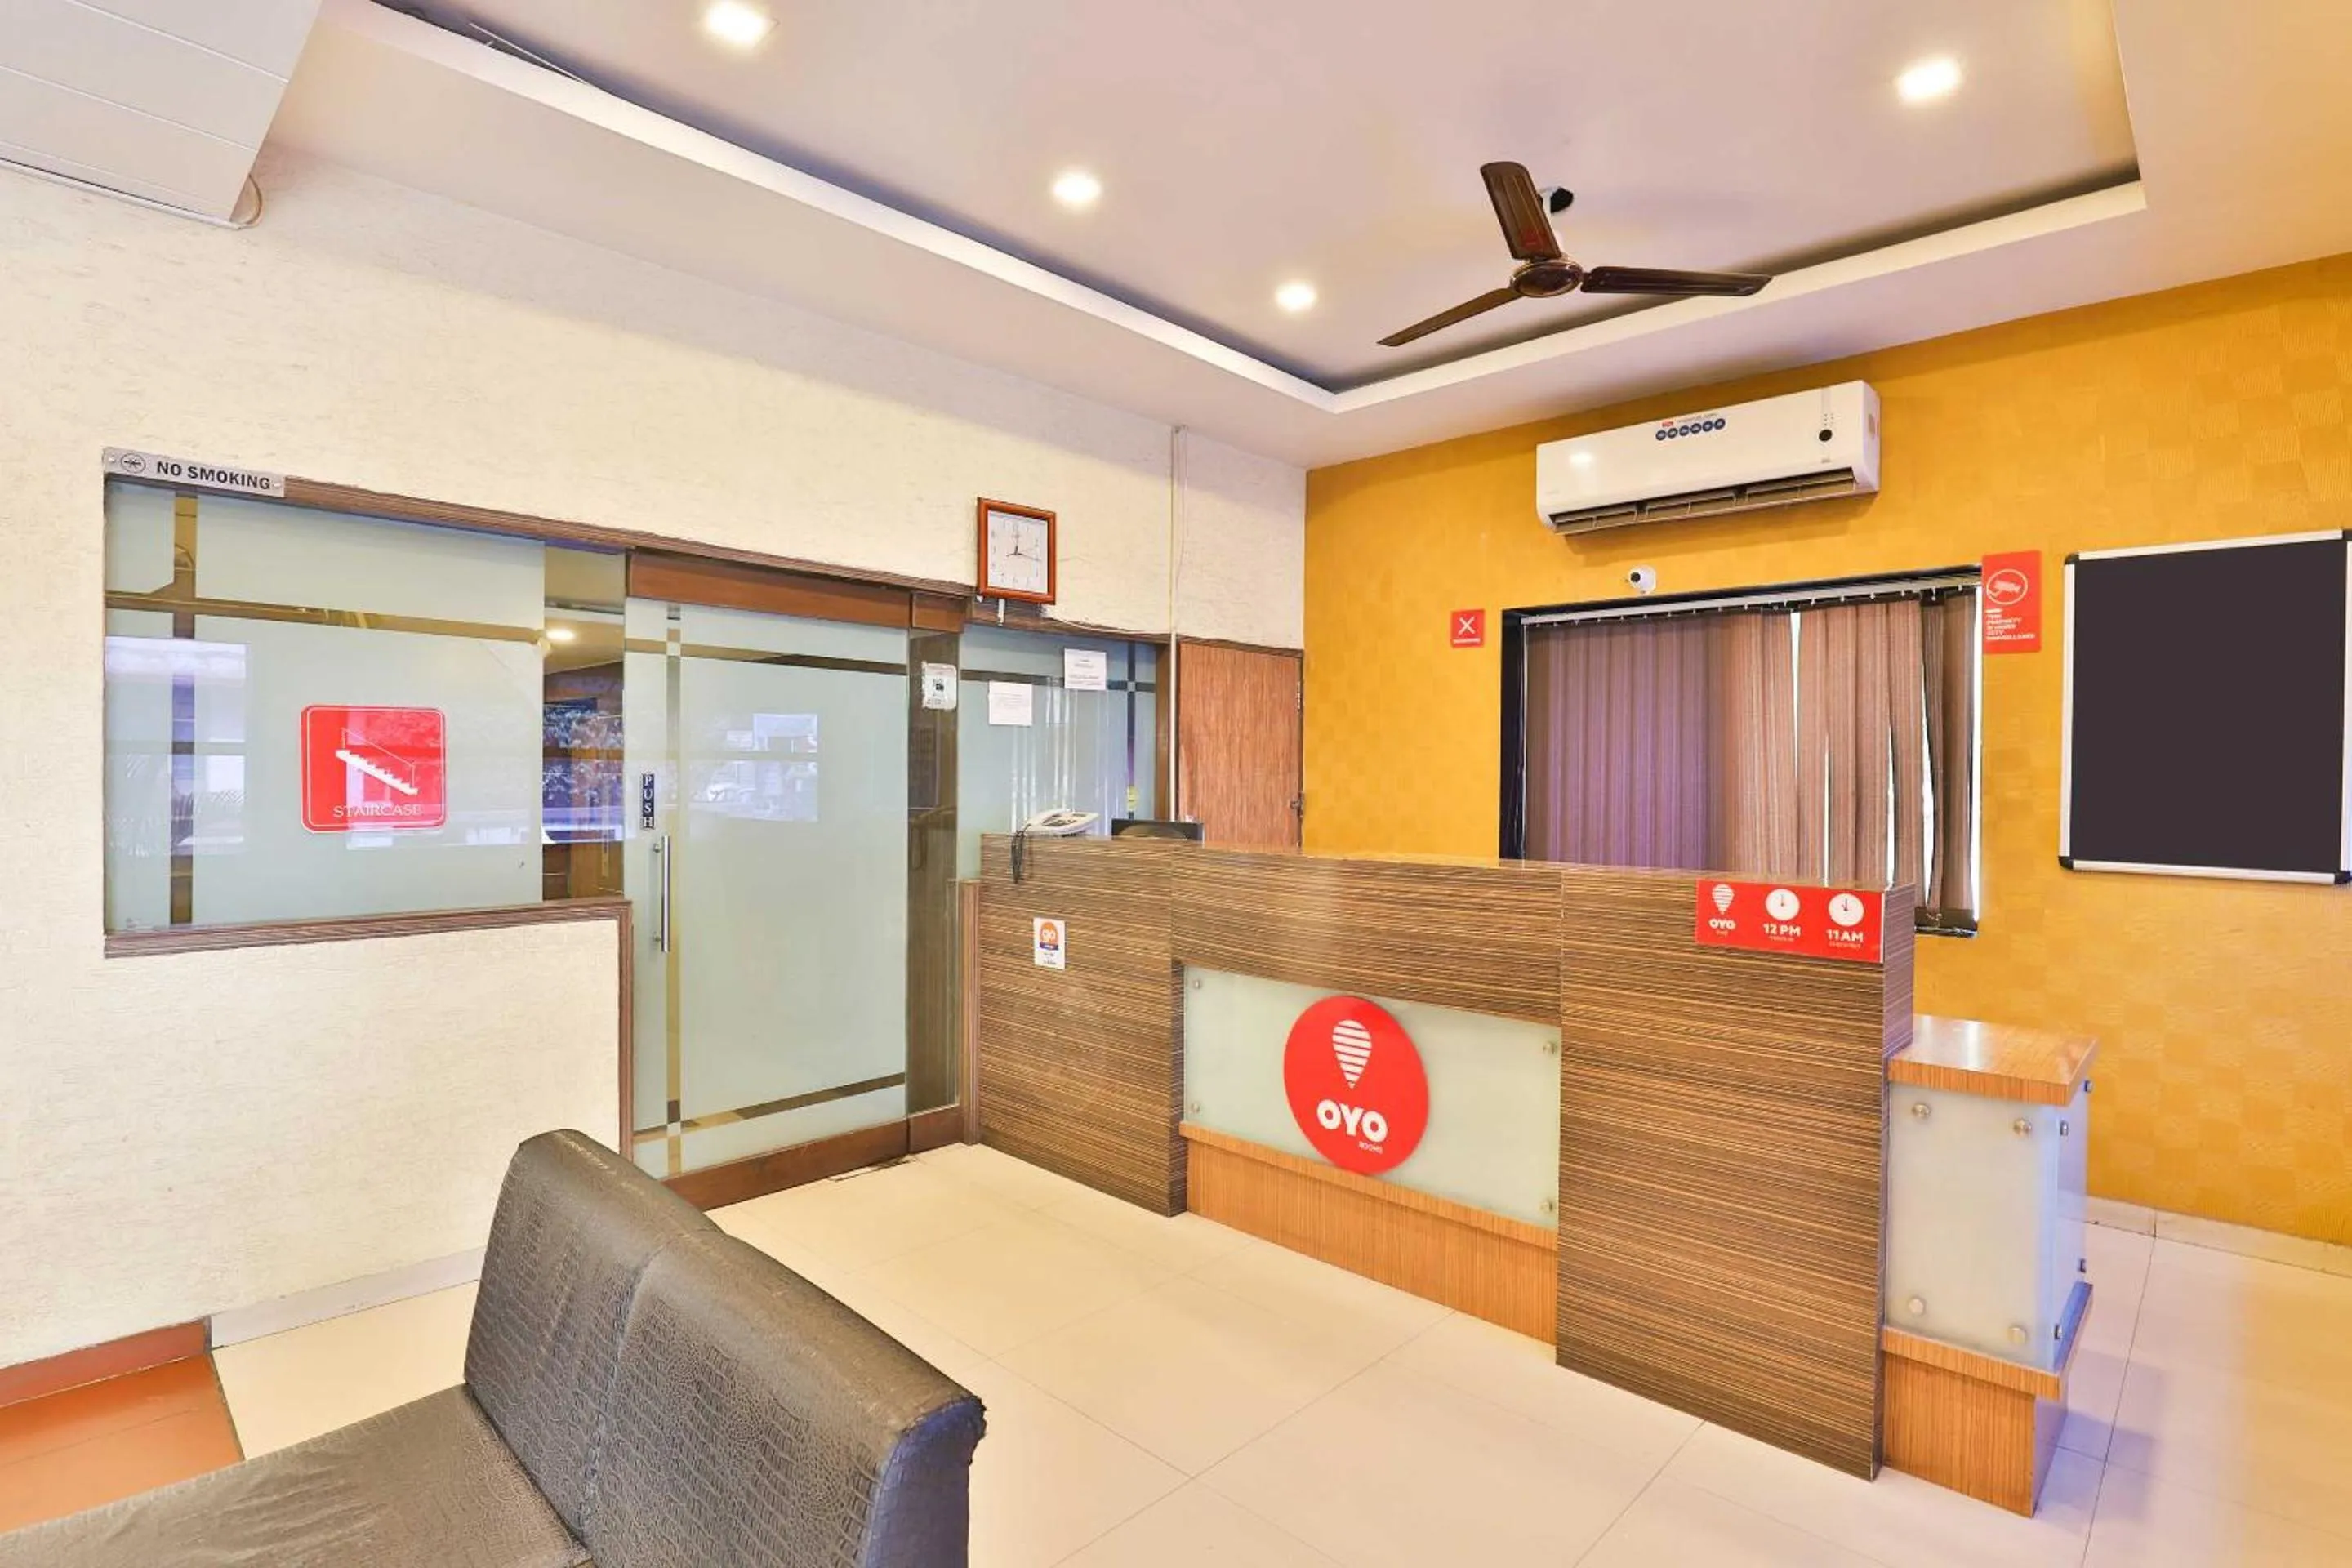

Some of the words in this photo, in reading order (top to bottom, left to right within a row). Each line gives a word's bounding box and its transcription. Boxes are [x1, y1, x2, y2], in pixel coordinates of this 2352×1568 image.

[156, 461, 182, 476] NO
[187, 466, 271, 490] SMOKING
[644, 775, 653, 827] PUSH
[333, 804, 422, 817] STAIRCASE
[1708, 918, 1736, 930] OYO
[1763, 923, 1778, 935] 12
[1780, 924, 1802, 938] PM
[1826, 929, 1839, 940] 11
[1841, 930, 1864, 942] AM
[1316, 1099, 1388, 1143] OYO
